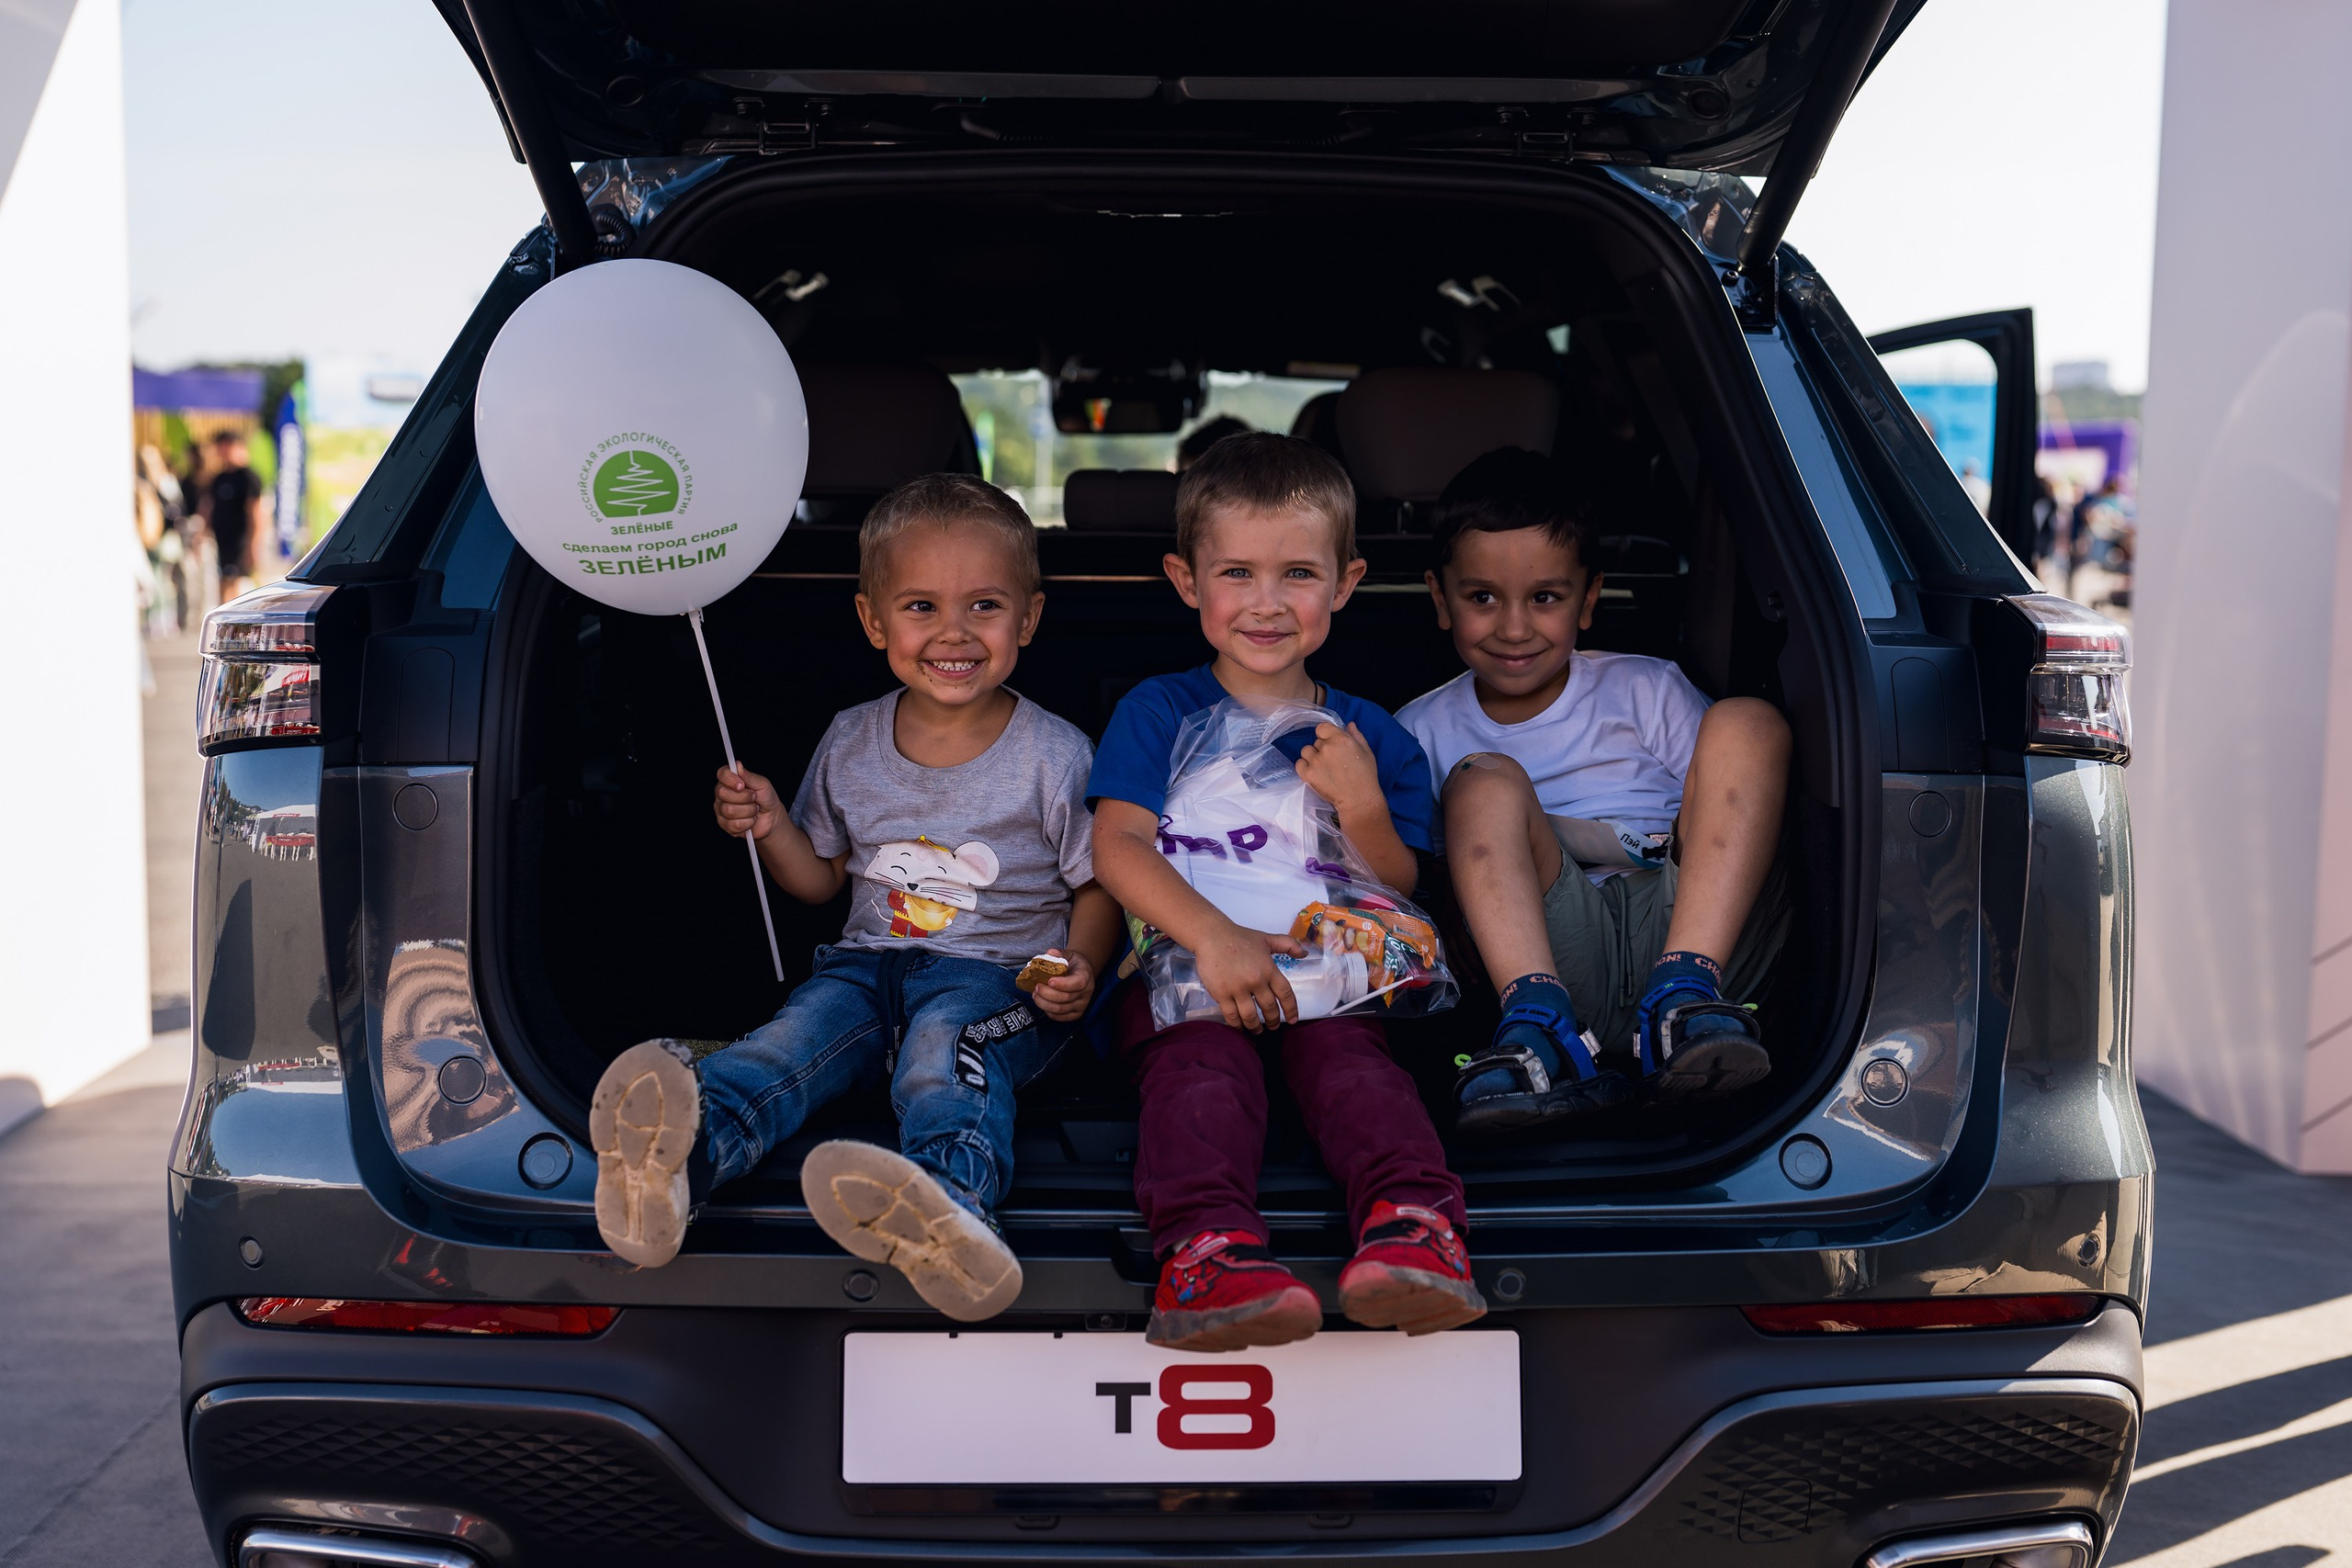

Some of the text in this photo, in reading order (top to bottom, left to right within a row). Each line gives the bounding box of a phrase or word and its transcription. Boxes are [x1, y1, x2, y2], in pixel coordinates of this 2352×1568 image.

[578, 432, 693, 524] РОССИЙСКАЯ ЭКОЛОГИЧЕСКАЯ ПАРТИЯ
[562, 523, 739, 554] сделаем город снова
[610, 521, 673, 536] ЗЕЛЁНЫЕ
[579, 543, 727, 575] ЗЕЛЁНЫМ
[1095, 1364, 1275, 1450] T8
